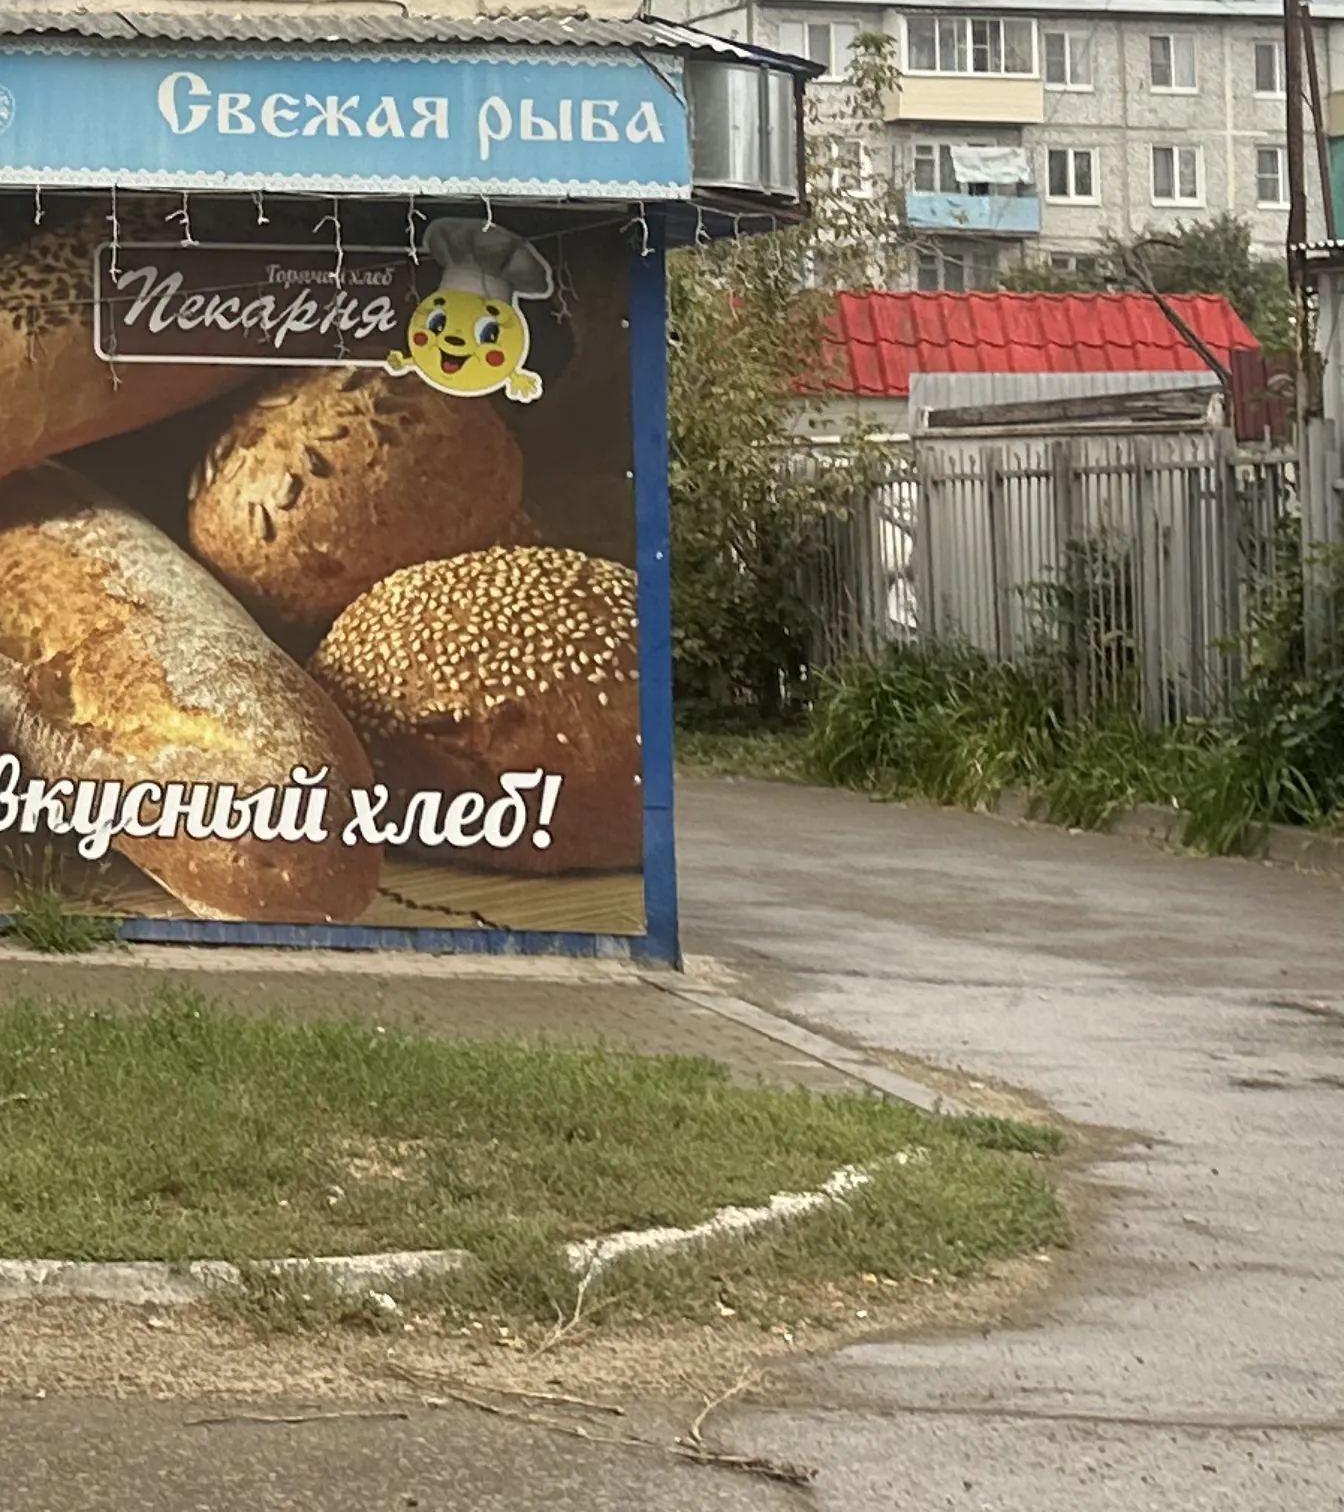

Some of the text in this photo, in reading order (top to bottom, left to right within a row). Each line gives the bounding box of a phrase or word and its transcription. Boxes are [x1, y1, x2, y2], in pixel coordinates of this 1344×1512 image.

[156, 70, 451, 141] Свежая
[117, 265, 398, 349] Пекарня
[342, 767, 563, 849] хлеб!
